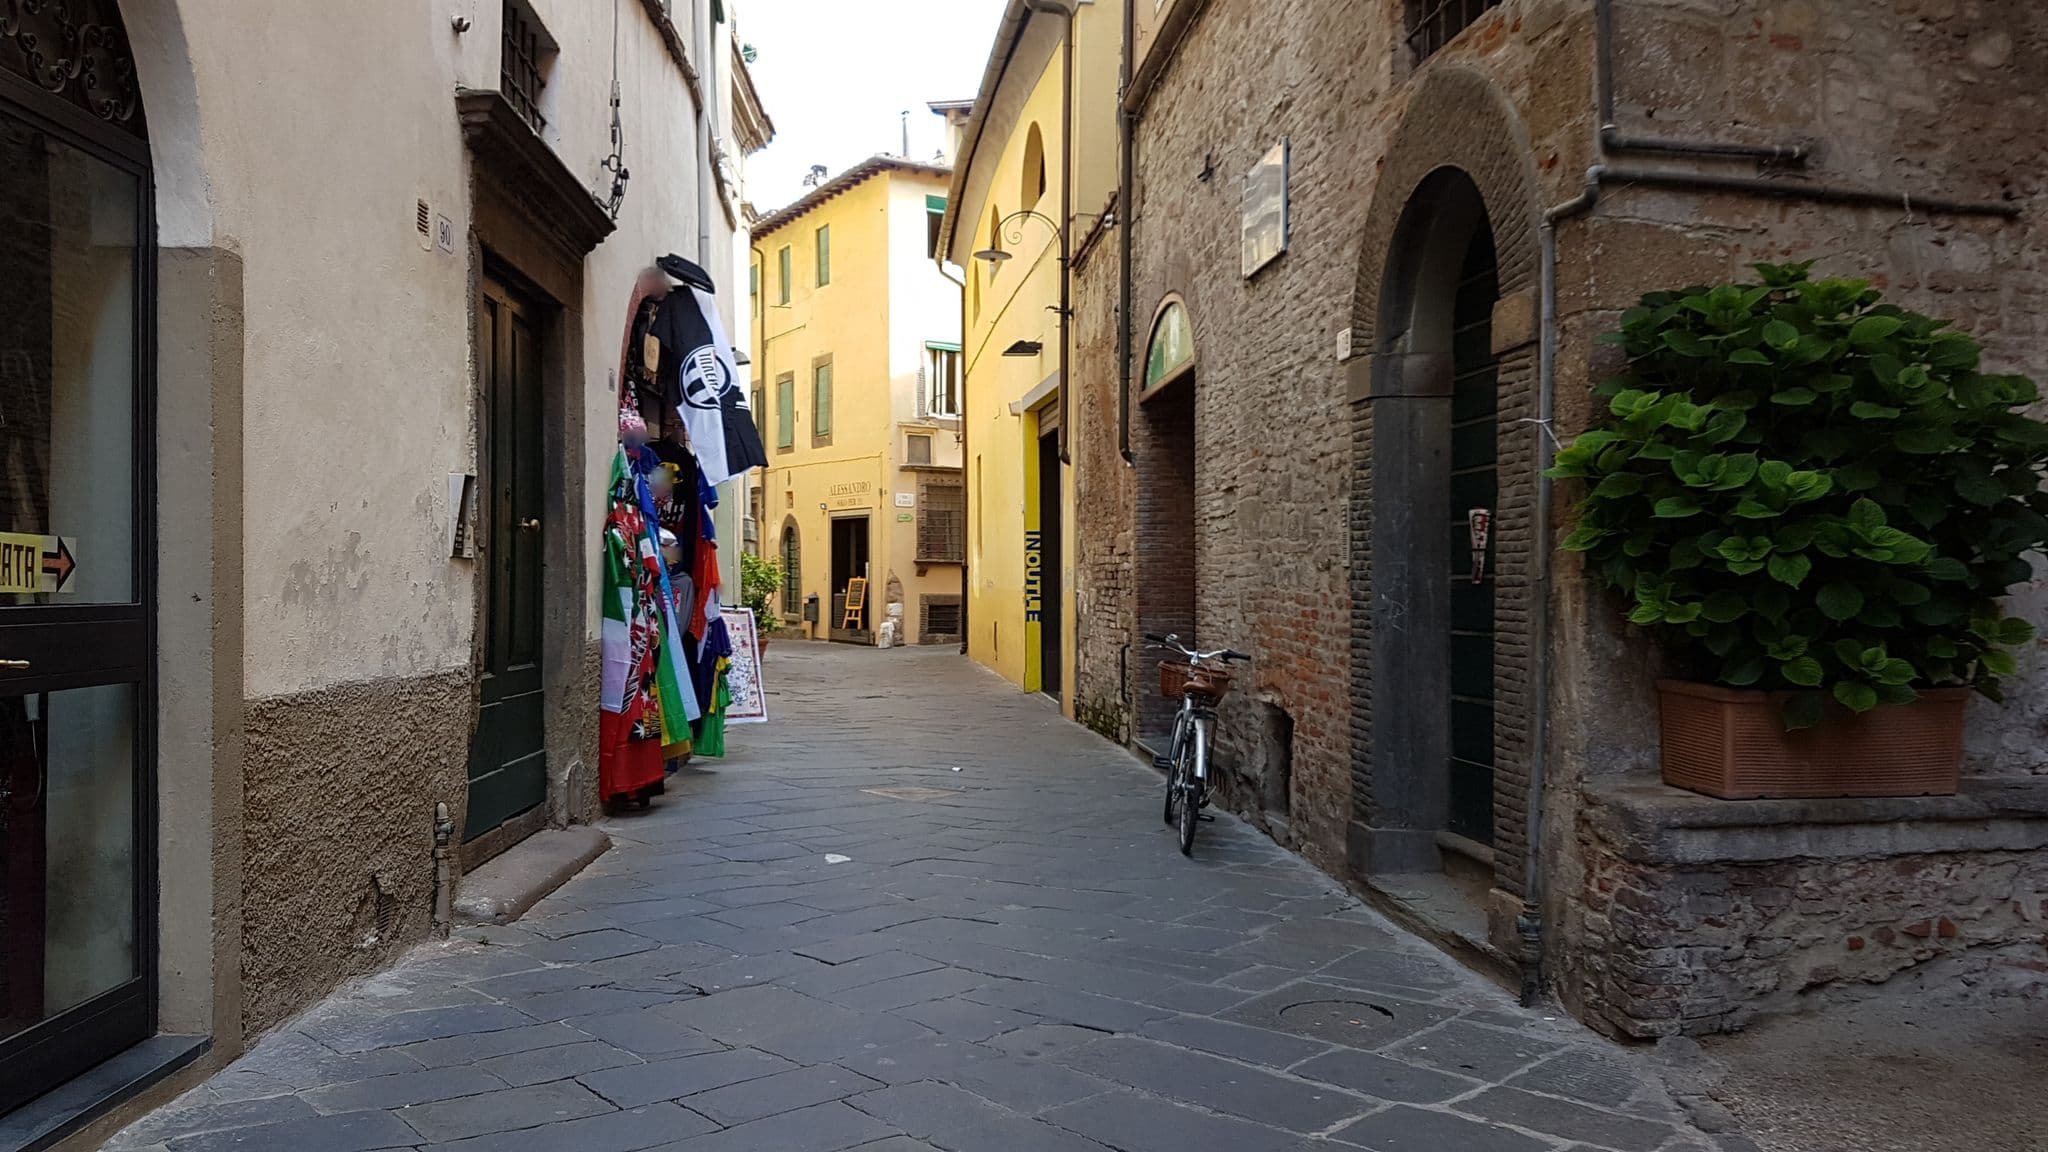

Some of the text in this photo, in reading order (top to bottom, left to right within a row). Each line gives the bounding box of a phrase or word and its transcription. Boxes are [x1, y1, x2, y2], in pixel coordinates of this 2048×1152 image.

[440, 222, 450, 246] 90
[829, 481, 871, 496] ALESSANDRO
[0, 543, 35, 588] ATA
